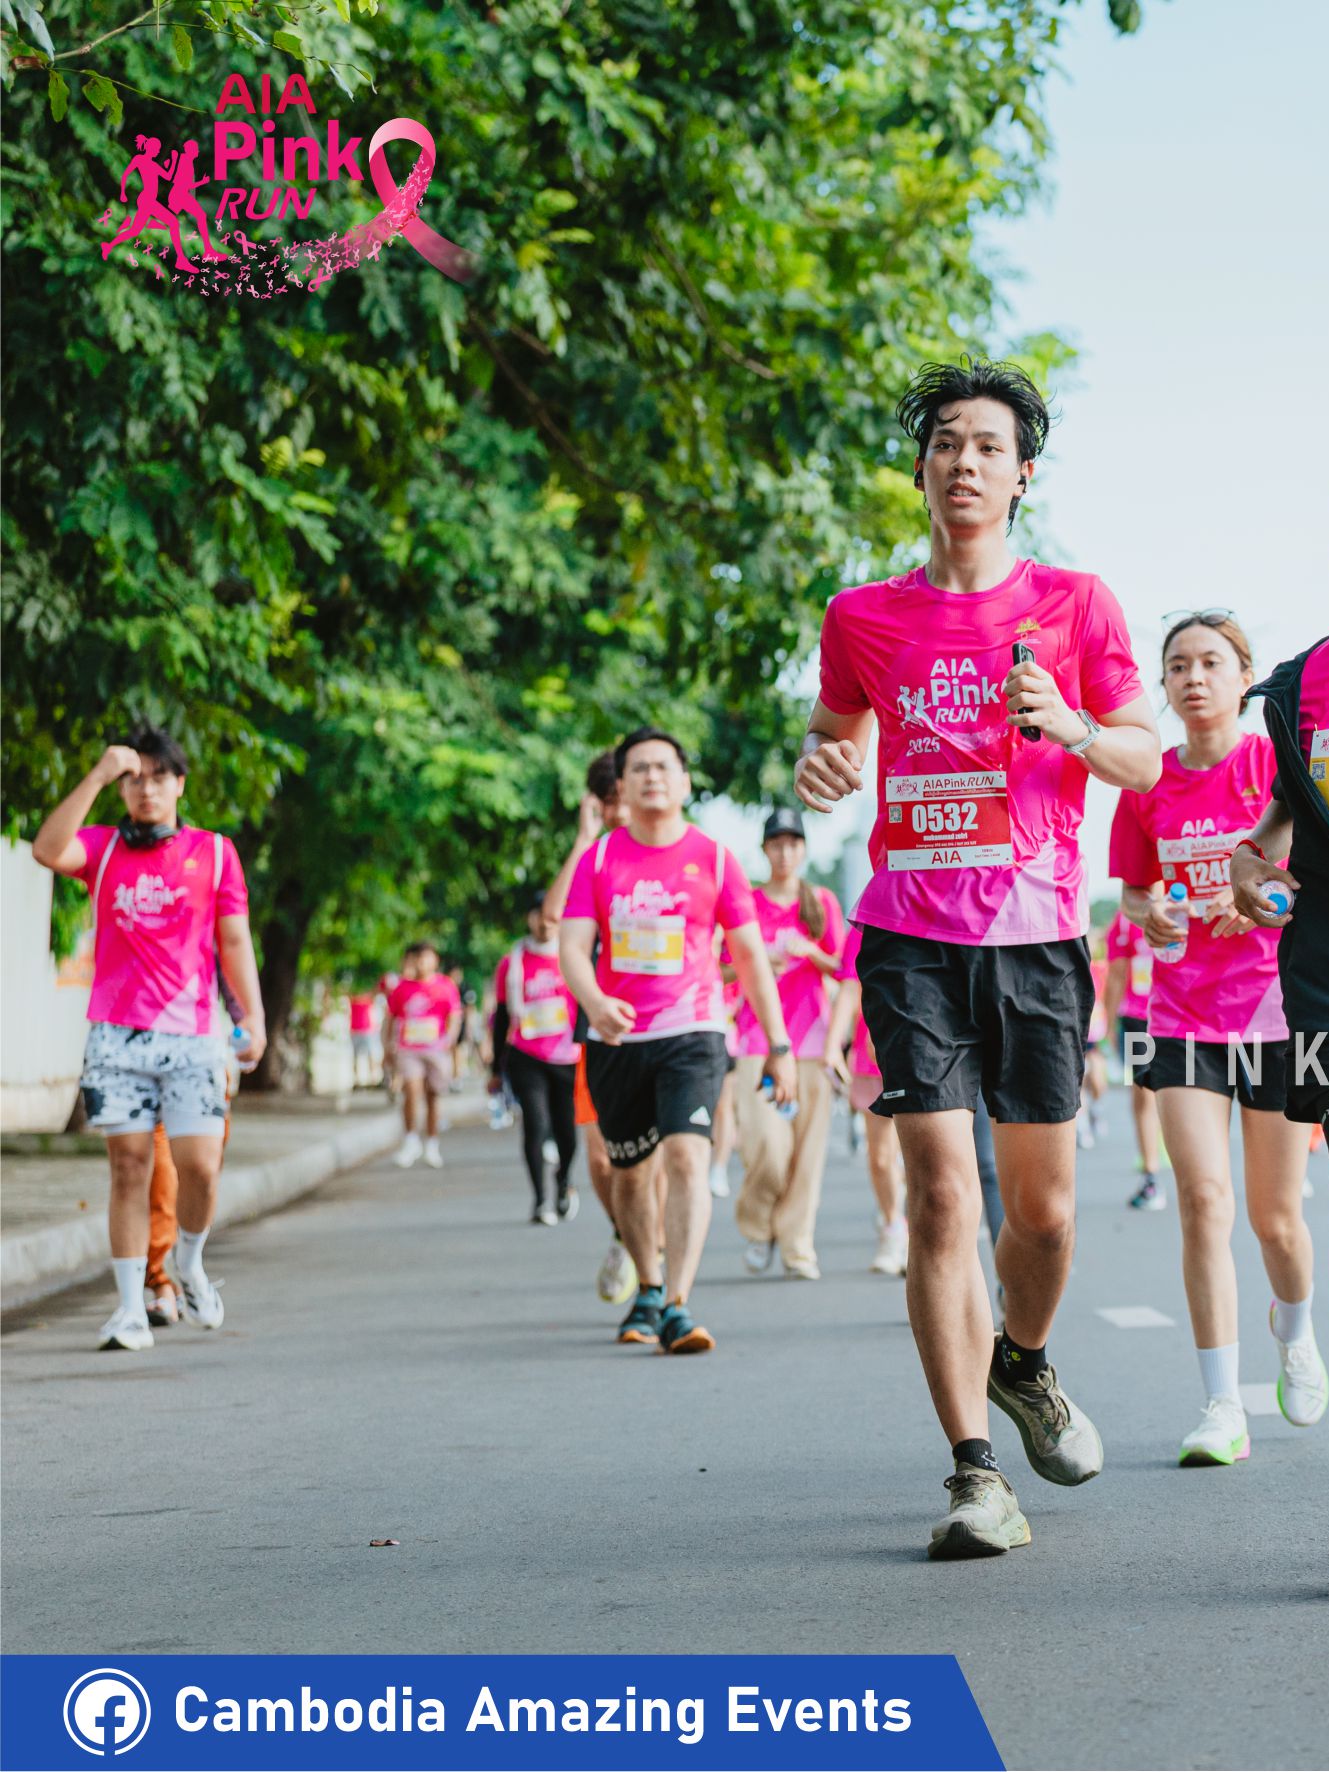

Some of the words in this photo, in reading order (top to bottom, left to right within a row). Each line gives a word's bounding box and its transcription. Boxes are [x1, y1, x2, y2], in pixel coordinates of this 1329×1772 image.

[930, 657, 978, 677] AIA
[930, 676, 1001, 706] Pink
[935, 706, 980, 723] RUN
[912, 801, 978, 832] 0532
[1181, 817, 1216, 837] AIA
[931, 850, 962, 864] AIA
